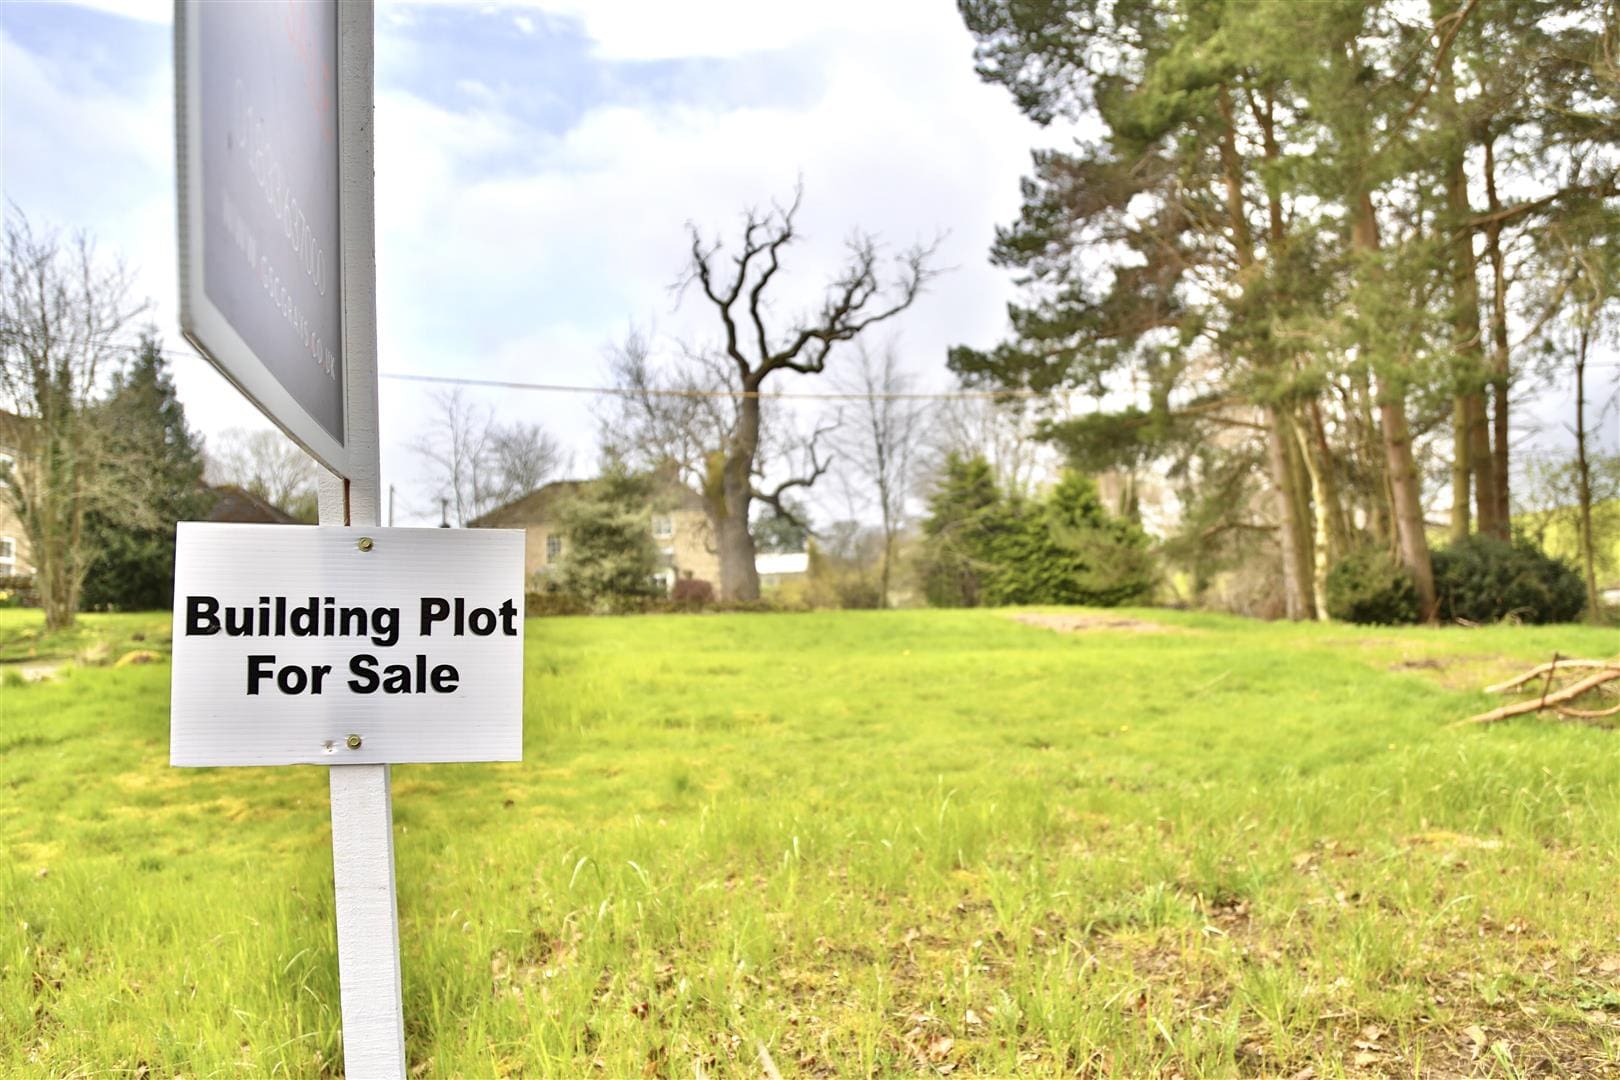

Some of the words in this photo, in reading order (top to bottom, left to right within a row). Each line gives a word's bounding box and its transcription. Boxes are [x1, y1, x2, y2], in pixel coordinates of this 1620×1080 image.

[186, 596, 399, 646] Building
[420, 597, 517, 637] Plot
[247, 655, 331, 695] For
[347, 653, 459, 695] Sale
